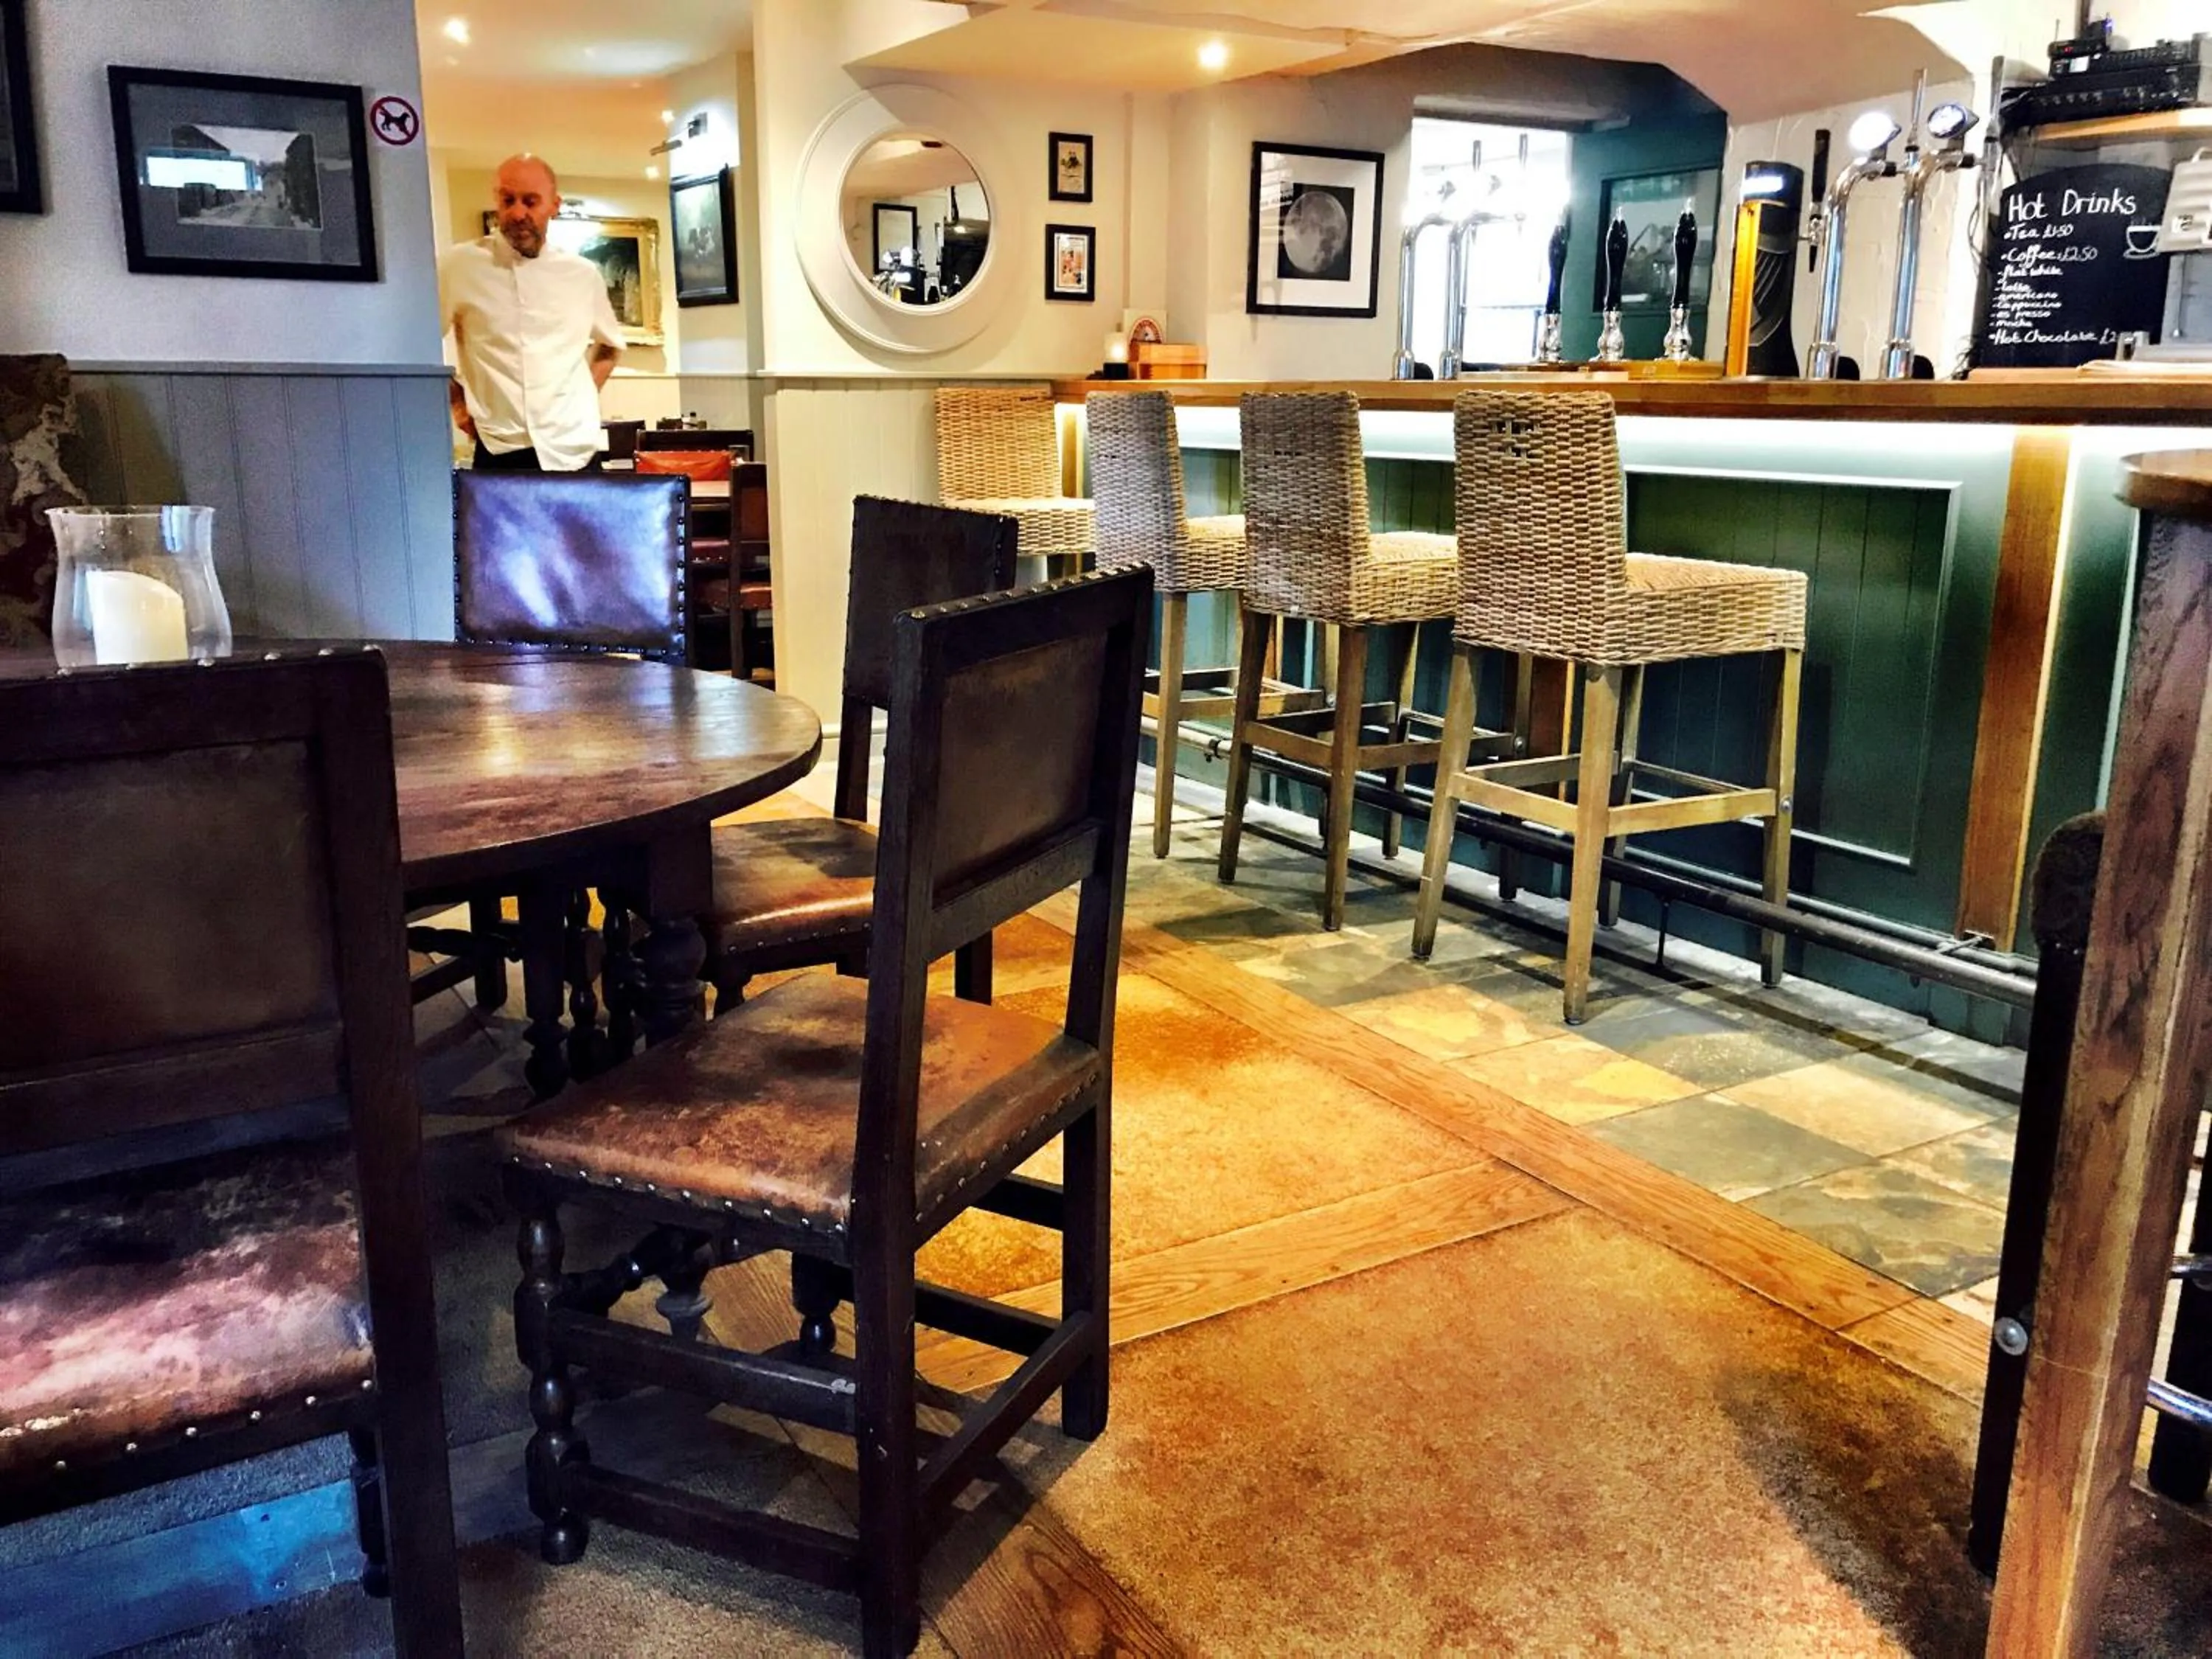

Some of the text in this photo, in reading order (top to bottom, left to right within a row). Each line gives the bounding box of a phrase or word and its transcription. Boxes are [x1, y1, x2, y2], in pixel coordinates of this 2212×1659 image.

[2008, 187, 2137, 222] Hot Drinks
[2009, 223, 2039, 240] Tea
[1994, 328, 2023, 345] Hot
[2024, 328, 2098, 344] Chocolate
